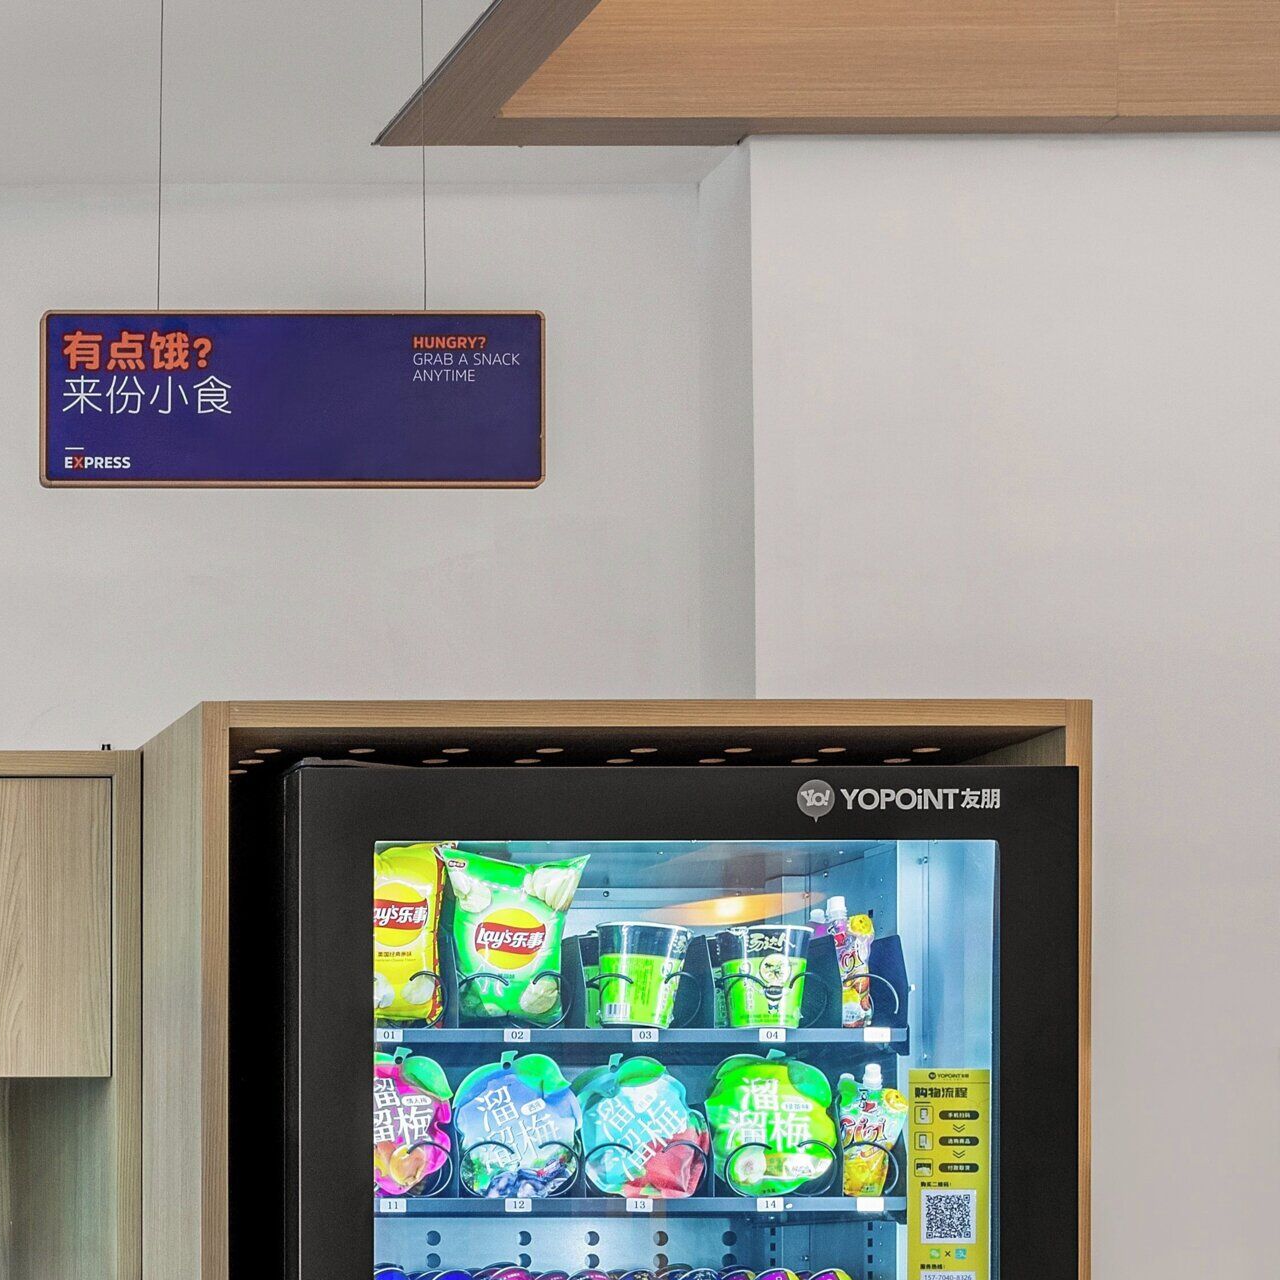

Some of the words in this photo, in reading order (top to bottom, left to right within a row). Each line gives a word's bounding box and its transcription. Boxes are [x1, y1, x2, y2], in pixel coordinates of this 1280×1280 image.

[413, 336, 487, 349] HUNGRY?
[63, 331, 213, 371] 有点饿?
[413, 352, 454, 366] GRAB
[458, 353, 469, 366] A
[473, 352, 520, 366] SNACK
[413, 369, 476, 382] ANYTIME
[62, 376, 232, 415] 来份小食
[64, 456, 131, 469] EXPRESS
[961, 788, 1000, 809] 友朋
[477, 924, 512, 949] Lay's
[512, 930, 545, 949] 乐事
[383, 1031, 396, 1040] 01
[511, 1031, 524, 1040] 02
[639, 1031, 652, 1040] 03
[766, 1031, 779, 1040] 04
[914, 1087, 968, 1099] 购物流程
[387, 1201, 399, 1210] 11
[513, 1201, 525, 1210] 12
[634, 1201, 646, 1210] 13
[764, 1200, 777, 1209] 14
